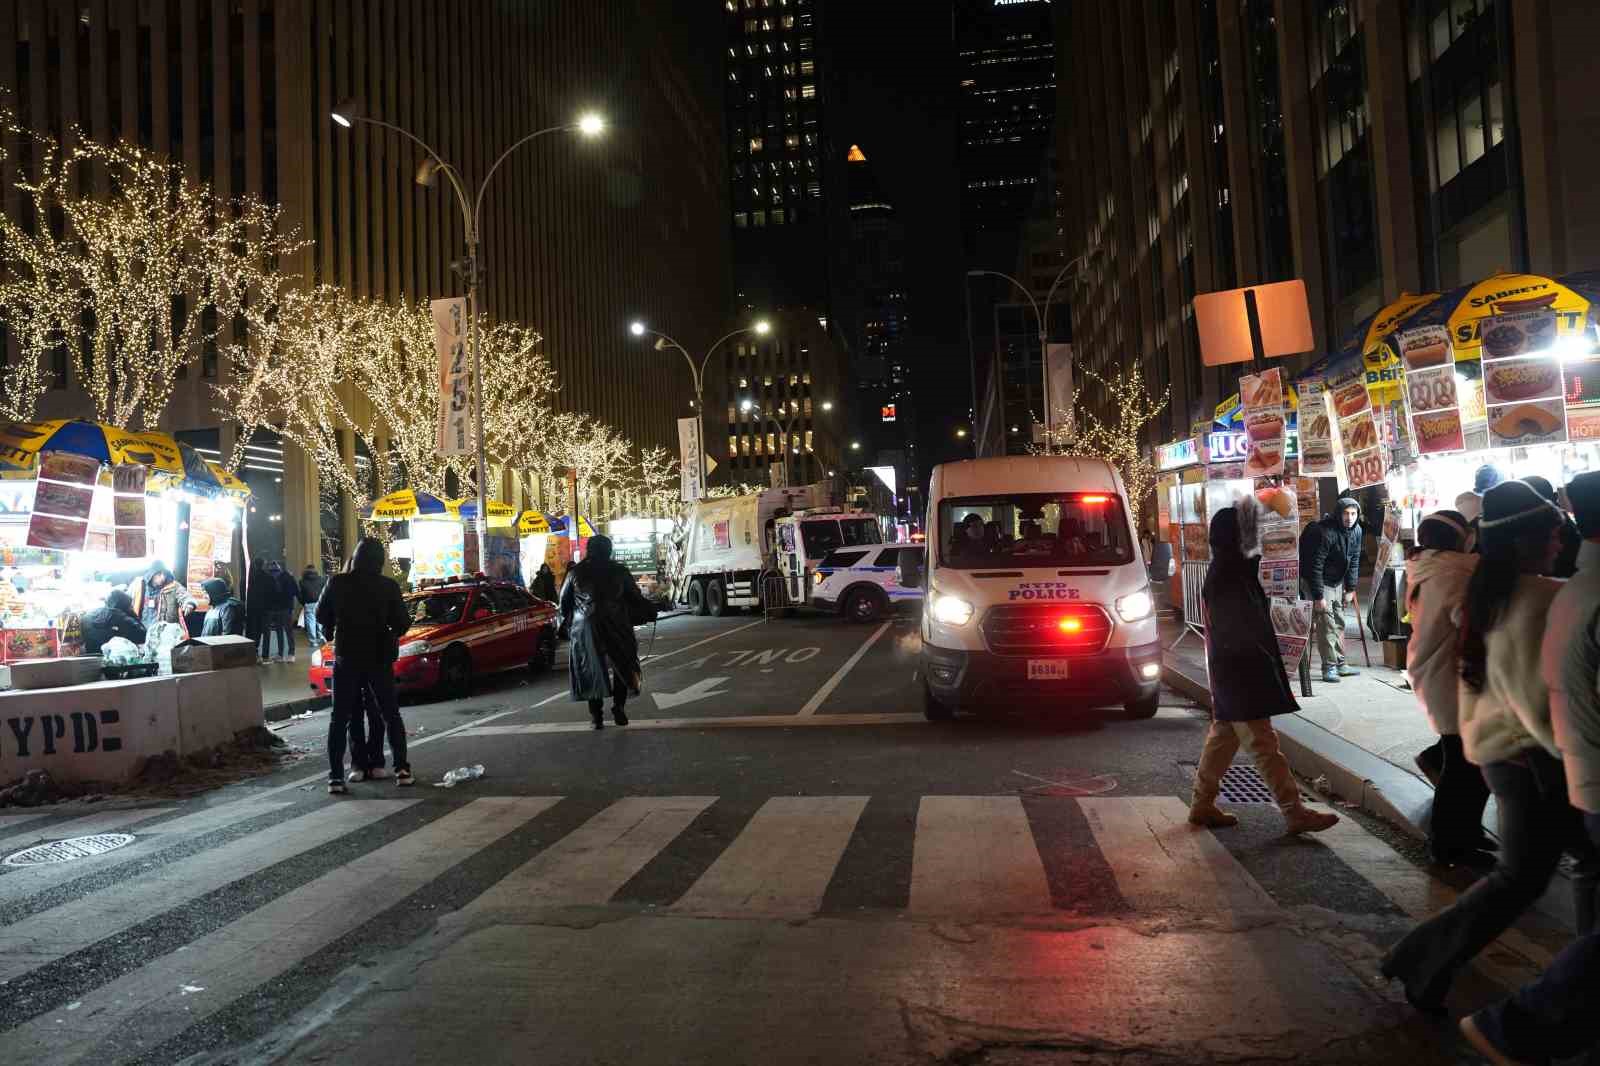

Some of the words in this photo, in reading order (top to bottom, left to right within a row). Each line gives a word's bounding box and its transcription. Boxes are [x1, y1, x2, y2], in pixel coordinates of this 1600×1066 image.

[1470, 284, 1548, 308] SABRETT
[376, 507, 415, 516] SABRETT
[1019, 582, 1067, 590] NYPD
[1008, 589, 1080, 600] POLICE
